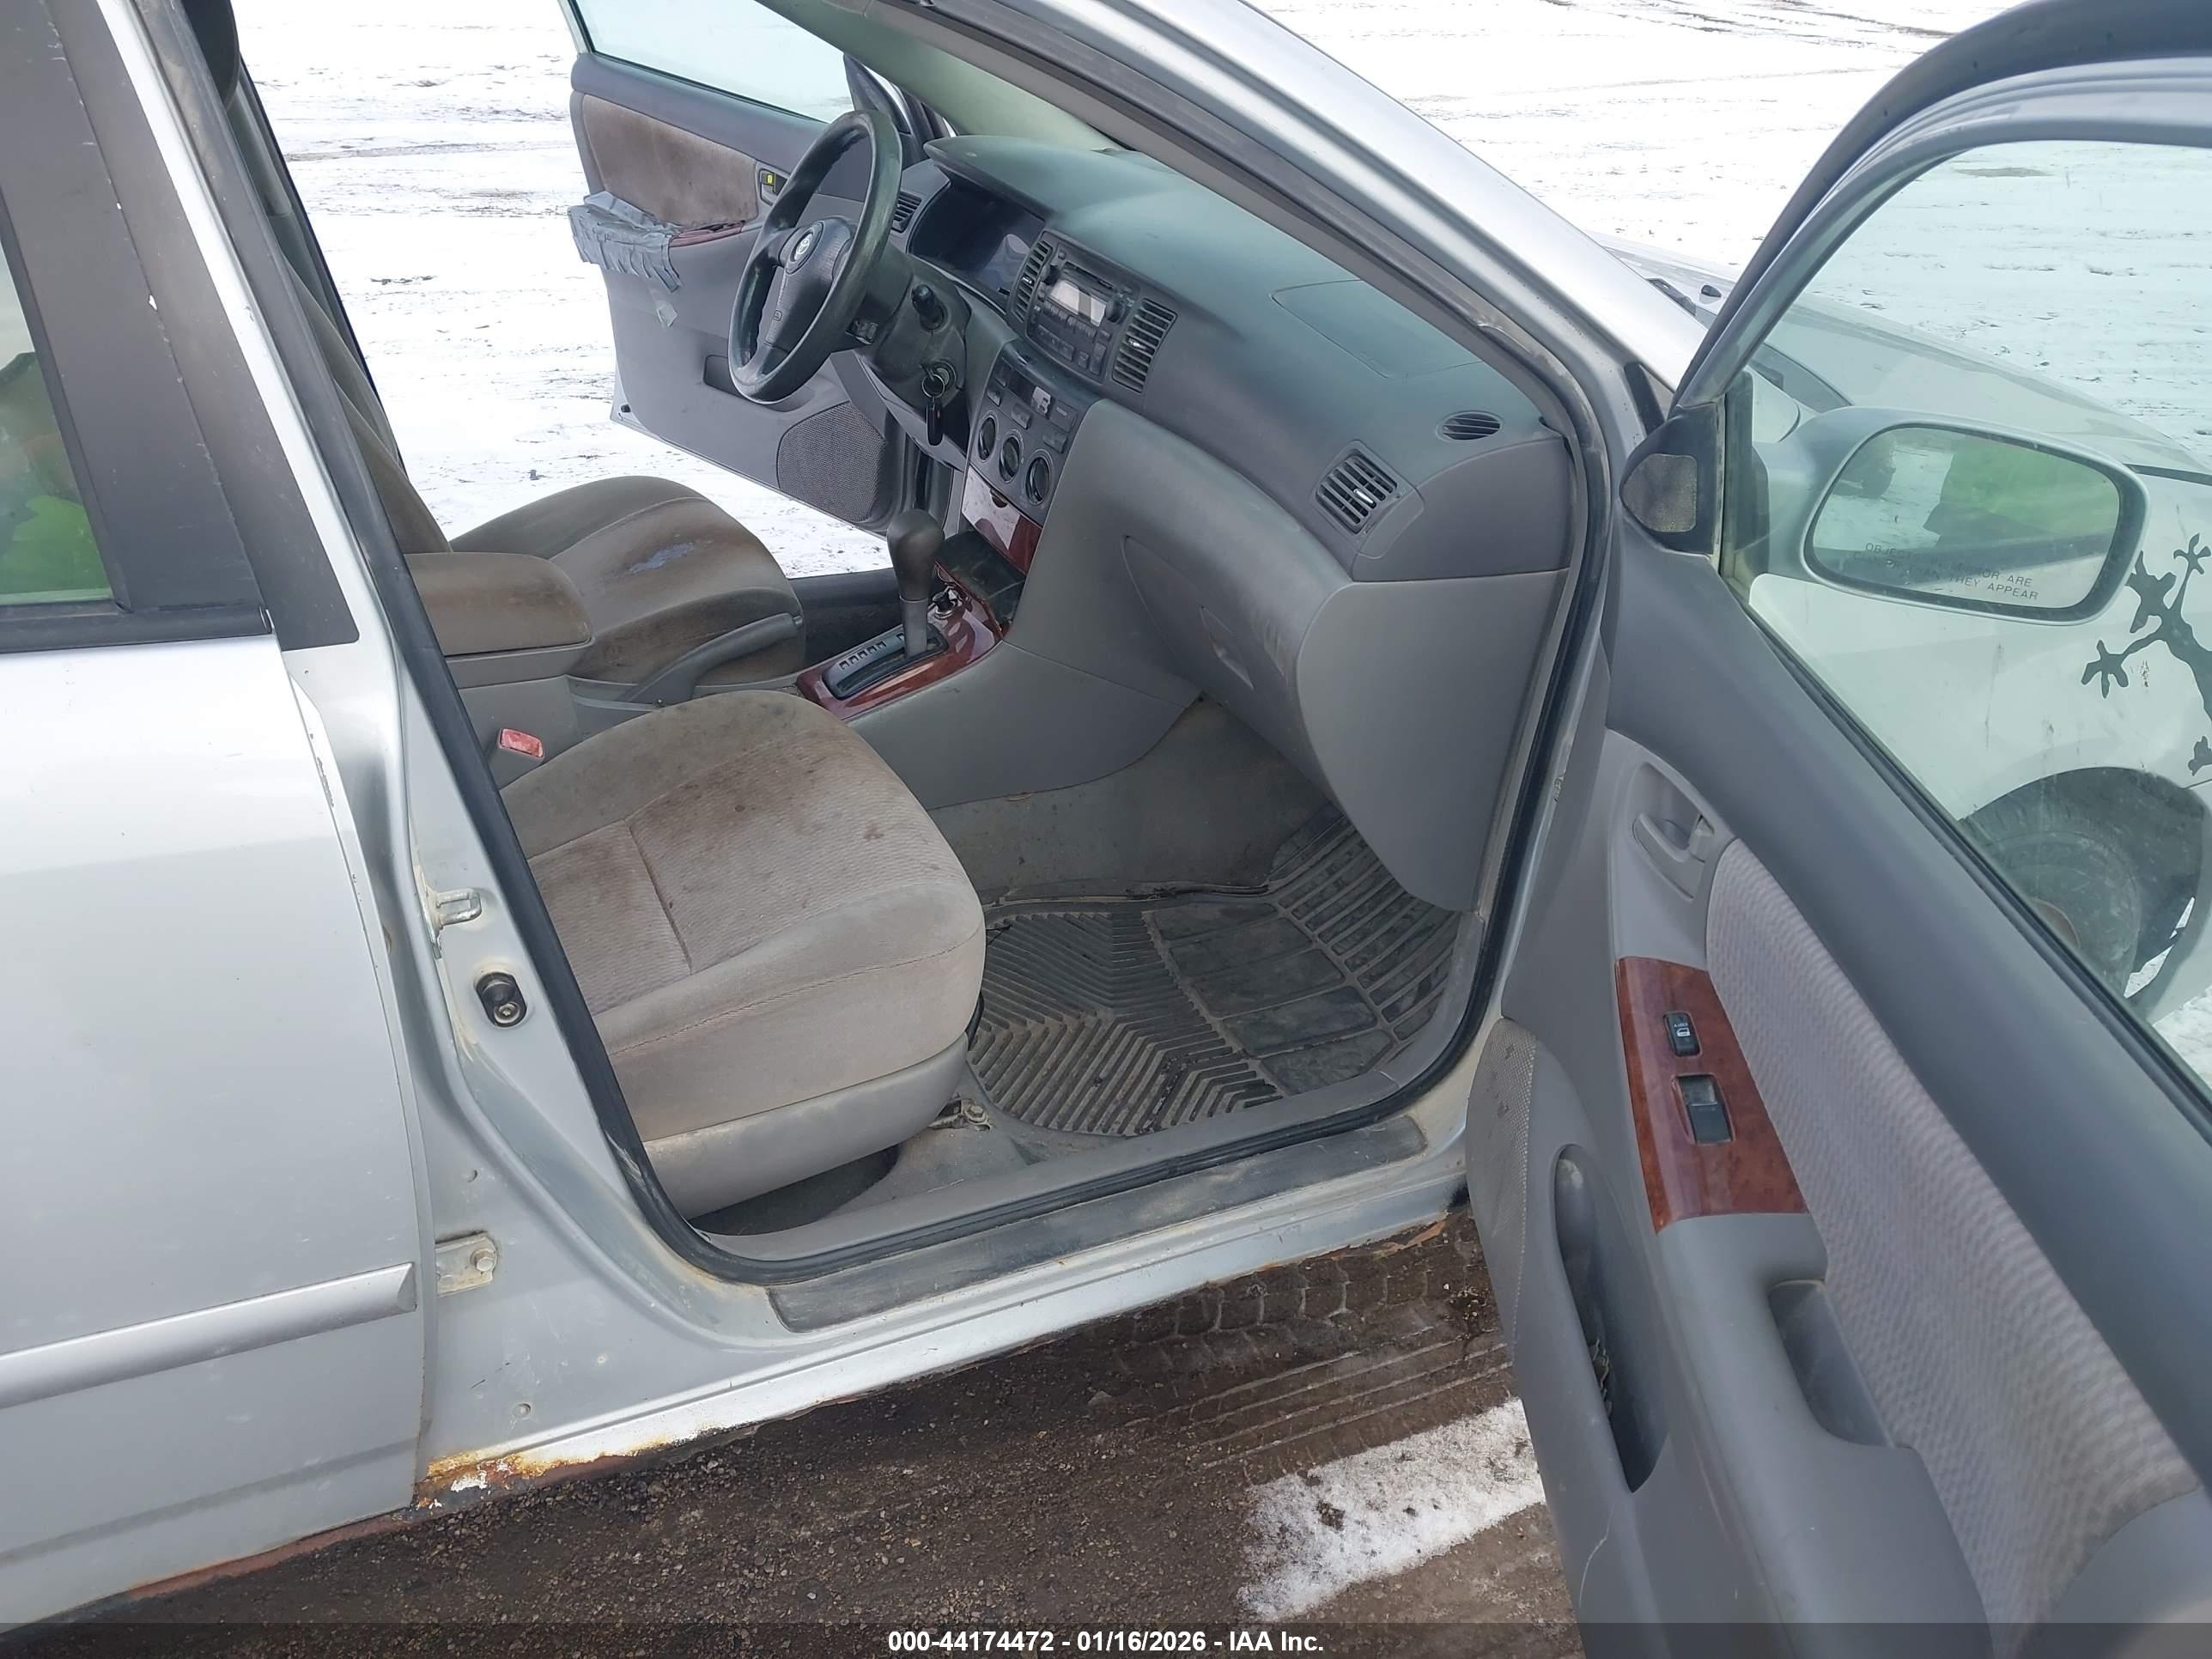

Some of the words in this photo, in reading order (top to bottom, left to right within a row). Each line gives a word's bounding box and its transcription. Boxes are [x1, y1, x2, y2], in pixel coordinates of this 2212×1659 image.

[1949, 574, 1980, 587] THEY
[1986, 582, 2039, 601] APPEAR
[2007, 574, 2033, 588] ARE
